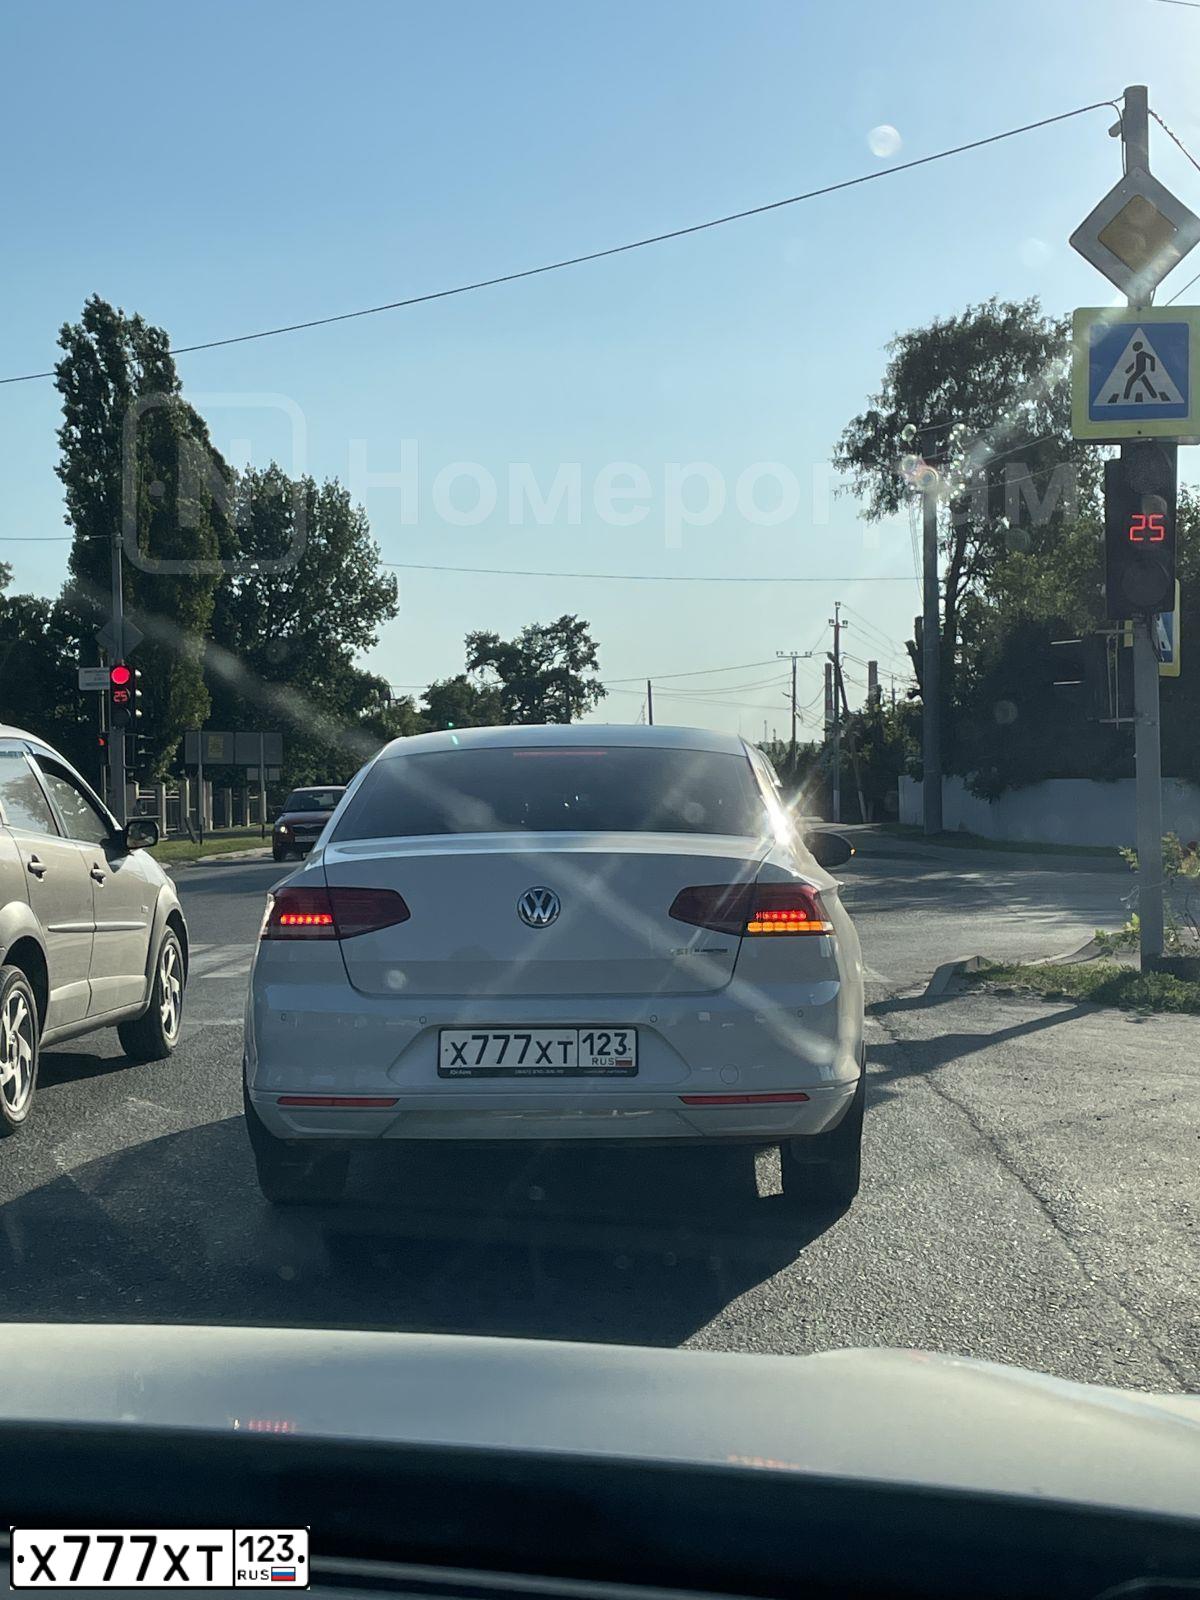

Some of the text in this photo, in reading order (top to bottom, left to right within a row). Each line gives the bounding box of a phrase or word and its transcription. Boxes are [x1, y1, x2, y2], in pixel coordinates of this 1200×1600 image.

[1129, 514, 1165, 541] 25
[113, 690, 128, 702] 25
[582, 1032, 628, 1056] 123
[592, 1057, 614, 1065] RUS
